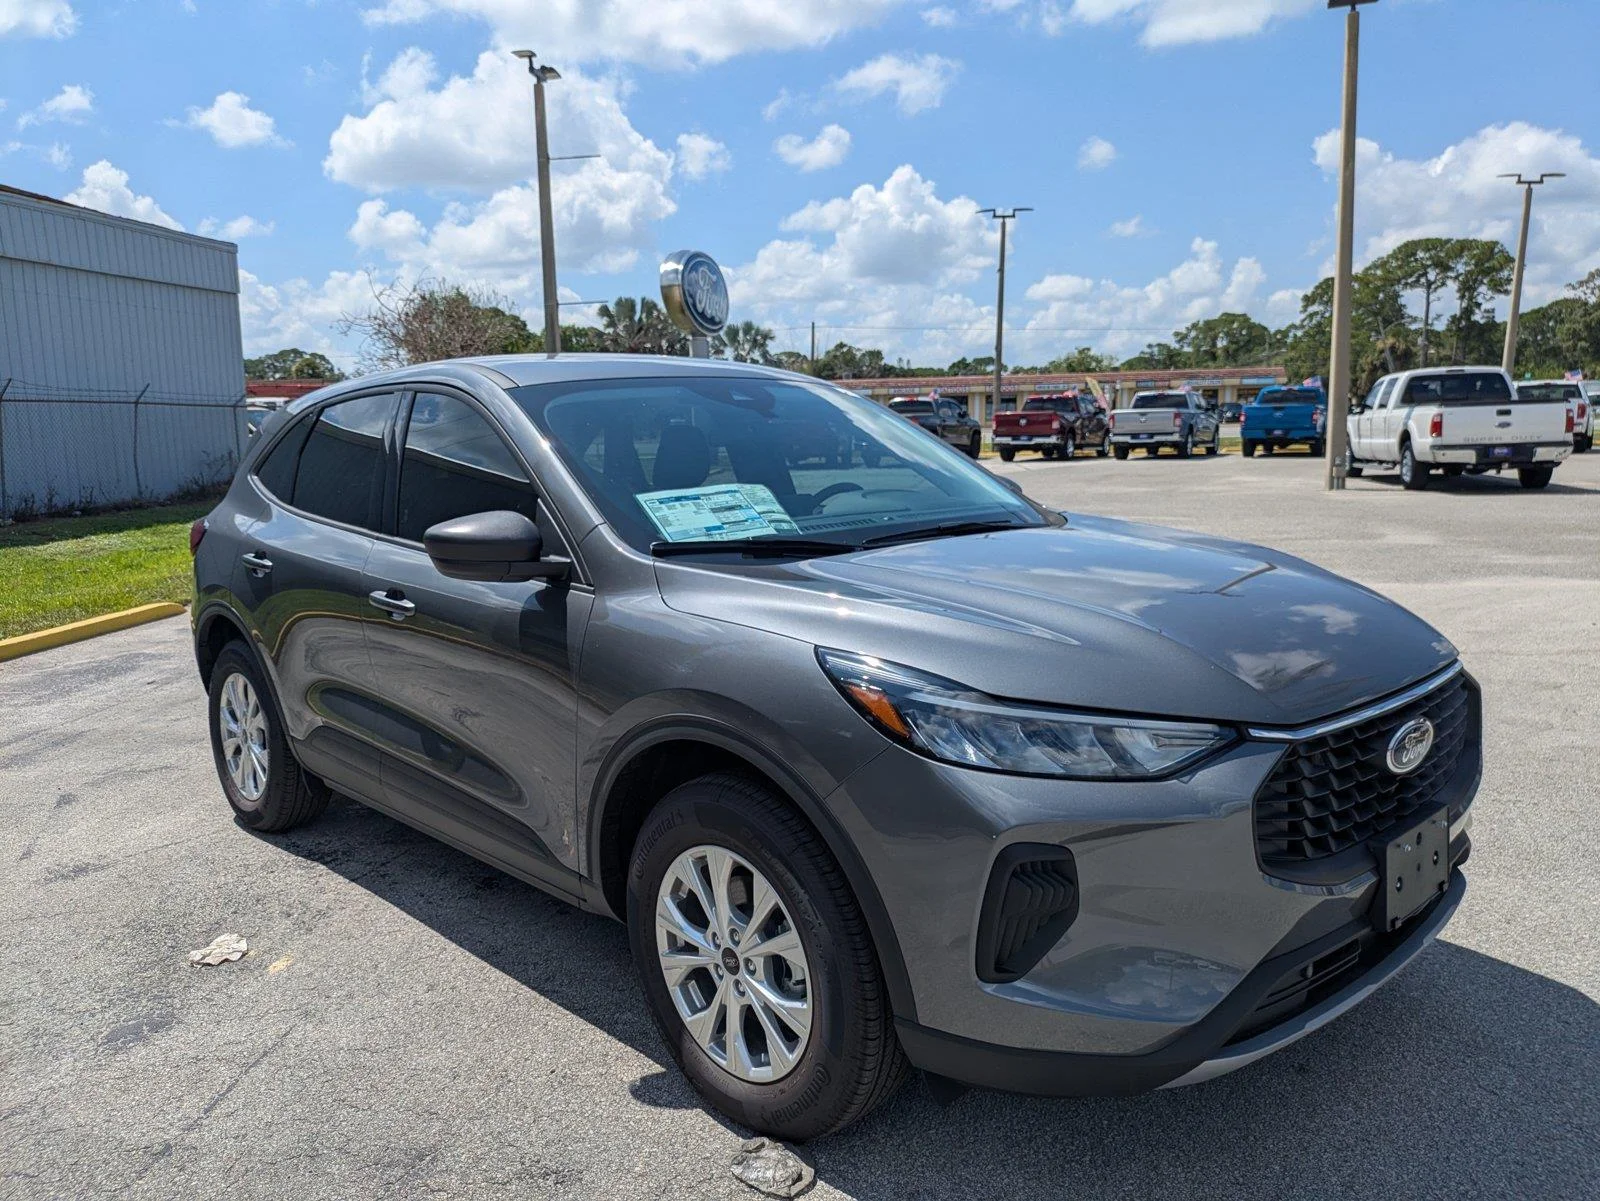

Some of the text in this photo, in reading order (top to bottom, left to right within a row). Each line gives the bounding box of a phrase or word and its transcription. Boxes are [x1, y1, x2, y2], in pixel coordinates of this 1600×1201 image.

[694, 266, 727, 322] Ford
[1463, 433, 1543, 443] SUPER DUTY
[1402, 724, 1428, 763] Ford
[769, 1062, 832, 1127] Continental
